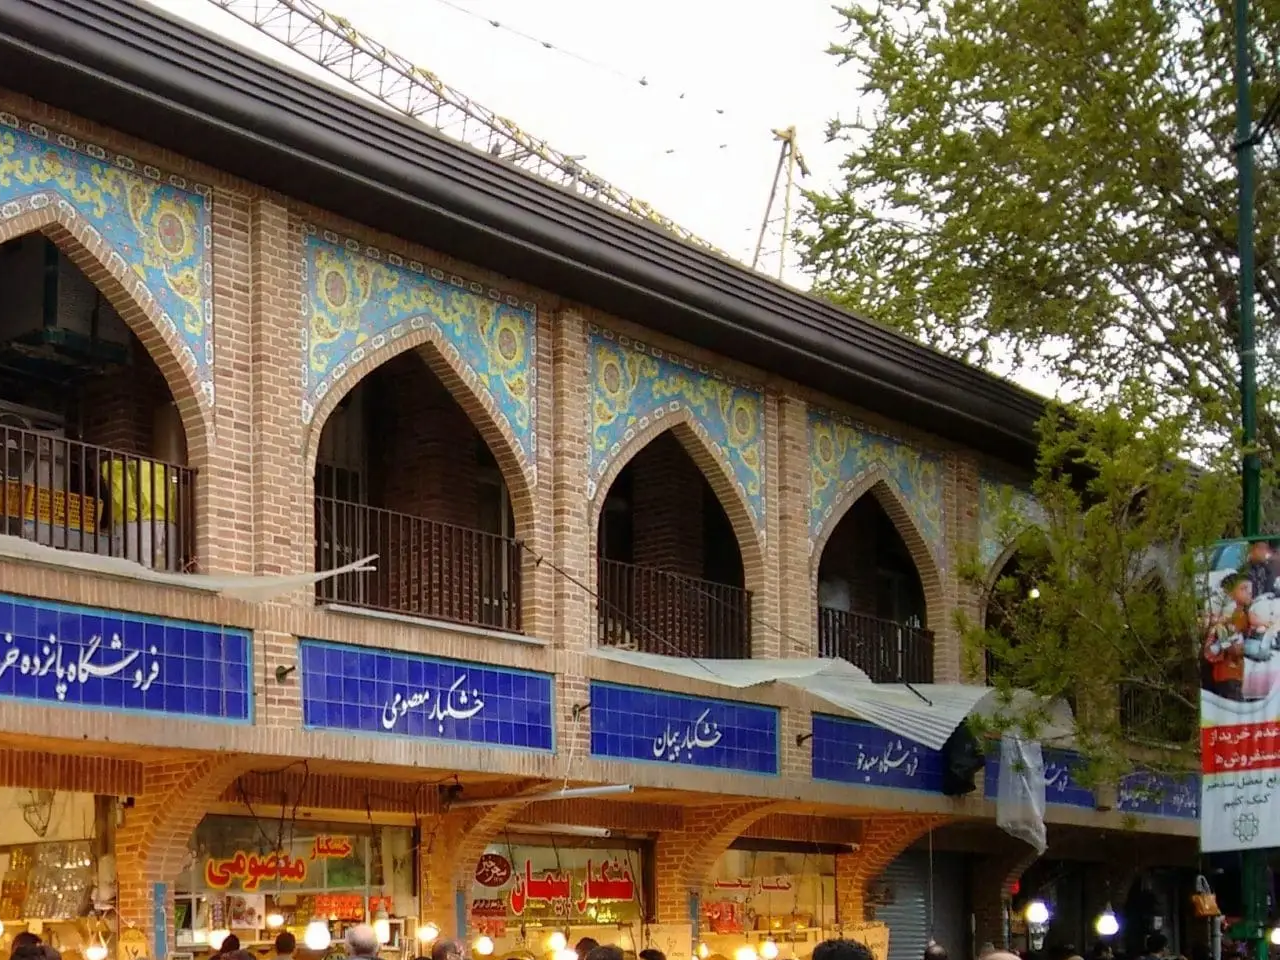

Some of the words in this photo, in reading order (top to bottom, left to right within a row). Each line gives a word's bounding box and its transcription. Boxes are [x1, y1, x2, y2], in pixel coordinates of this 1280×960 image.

[21, 634, 67, 700] پانزده
[67, 633, 160, 691] فروشگاه
[382, 689, 431, 730] معصومی
[428, 674, 484, 734] خشکبار
[653, 724, 683, 762] پیمان
[680, 708, 722, 758] خشکبار
